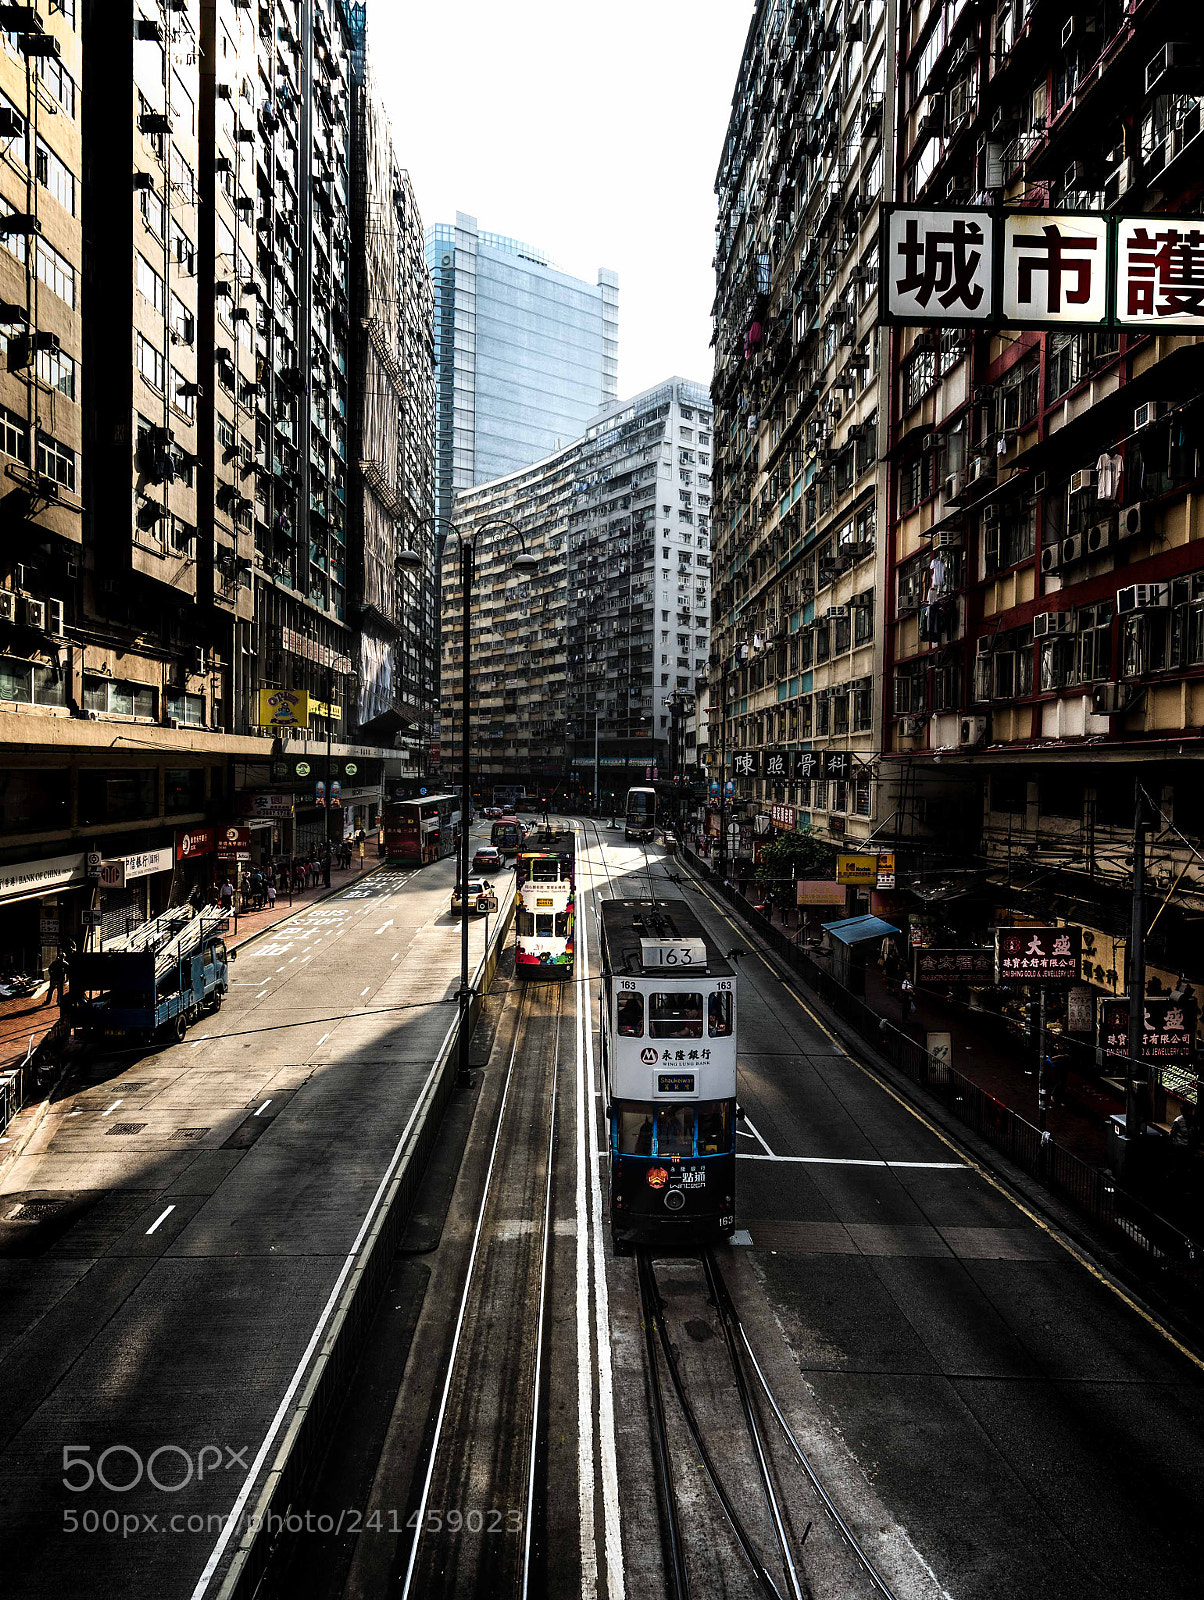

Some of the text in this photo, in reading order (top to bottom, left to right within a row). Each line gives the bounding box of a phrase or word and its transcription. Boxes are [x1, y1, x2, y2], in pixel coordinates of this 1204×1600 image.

[896, 219, 1204, 317] 城市護
[734, 752, 848, 777] 陳照骨科
[19, 873, 35, 884] BANK
[35, 872, 43, 881] OF
[44, 870, 61, 879] CHINA
[343, 890, 373, 898] 站
[270, 927, 320, 939] 巴士
[250, 942, 294, 956] 站
[1025, 934, 1072, 956] 大盛
[660, 949, 692, 965] 163
[1003, 958, 1076, 968] 珠寶金行有限公司
[621, 981, 635, 990] 163
[717, 981, 732, 990] 163
[1107, 1033, 1190, 1045] 珠寶行有限公司
[662, 1049, 711, 1061] 永隆銀行
[1152, 1047, 1179, 1055] JEWELLERY
[670, 1172, 706, 1183] 一點通
[719, 1215, 734, 1226] 163
